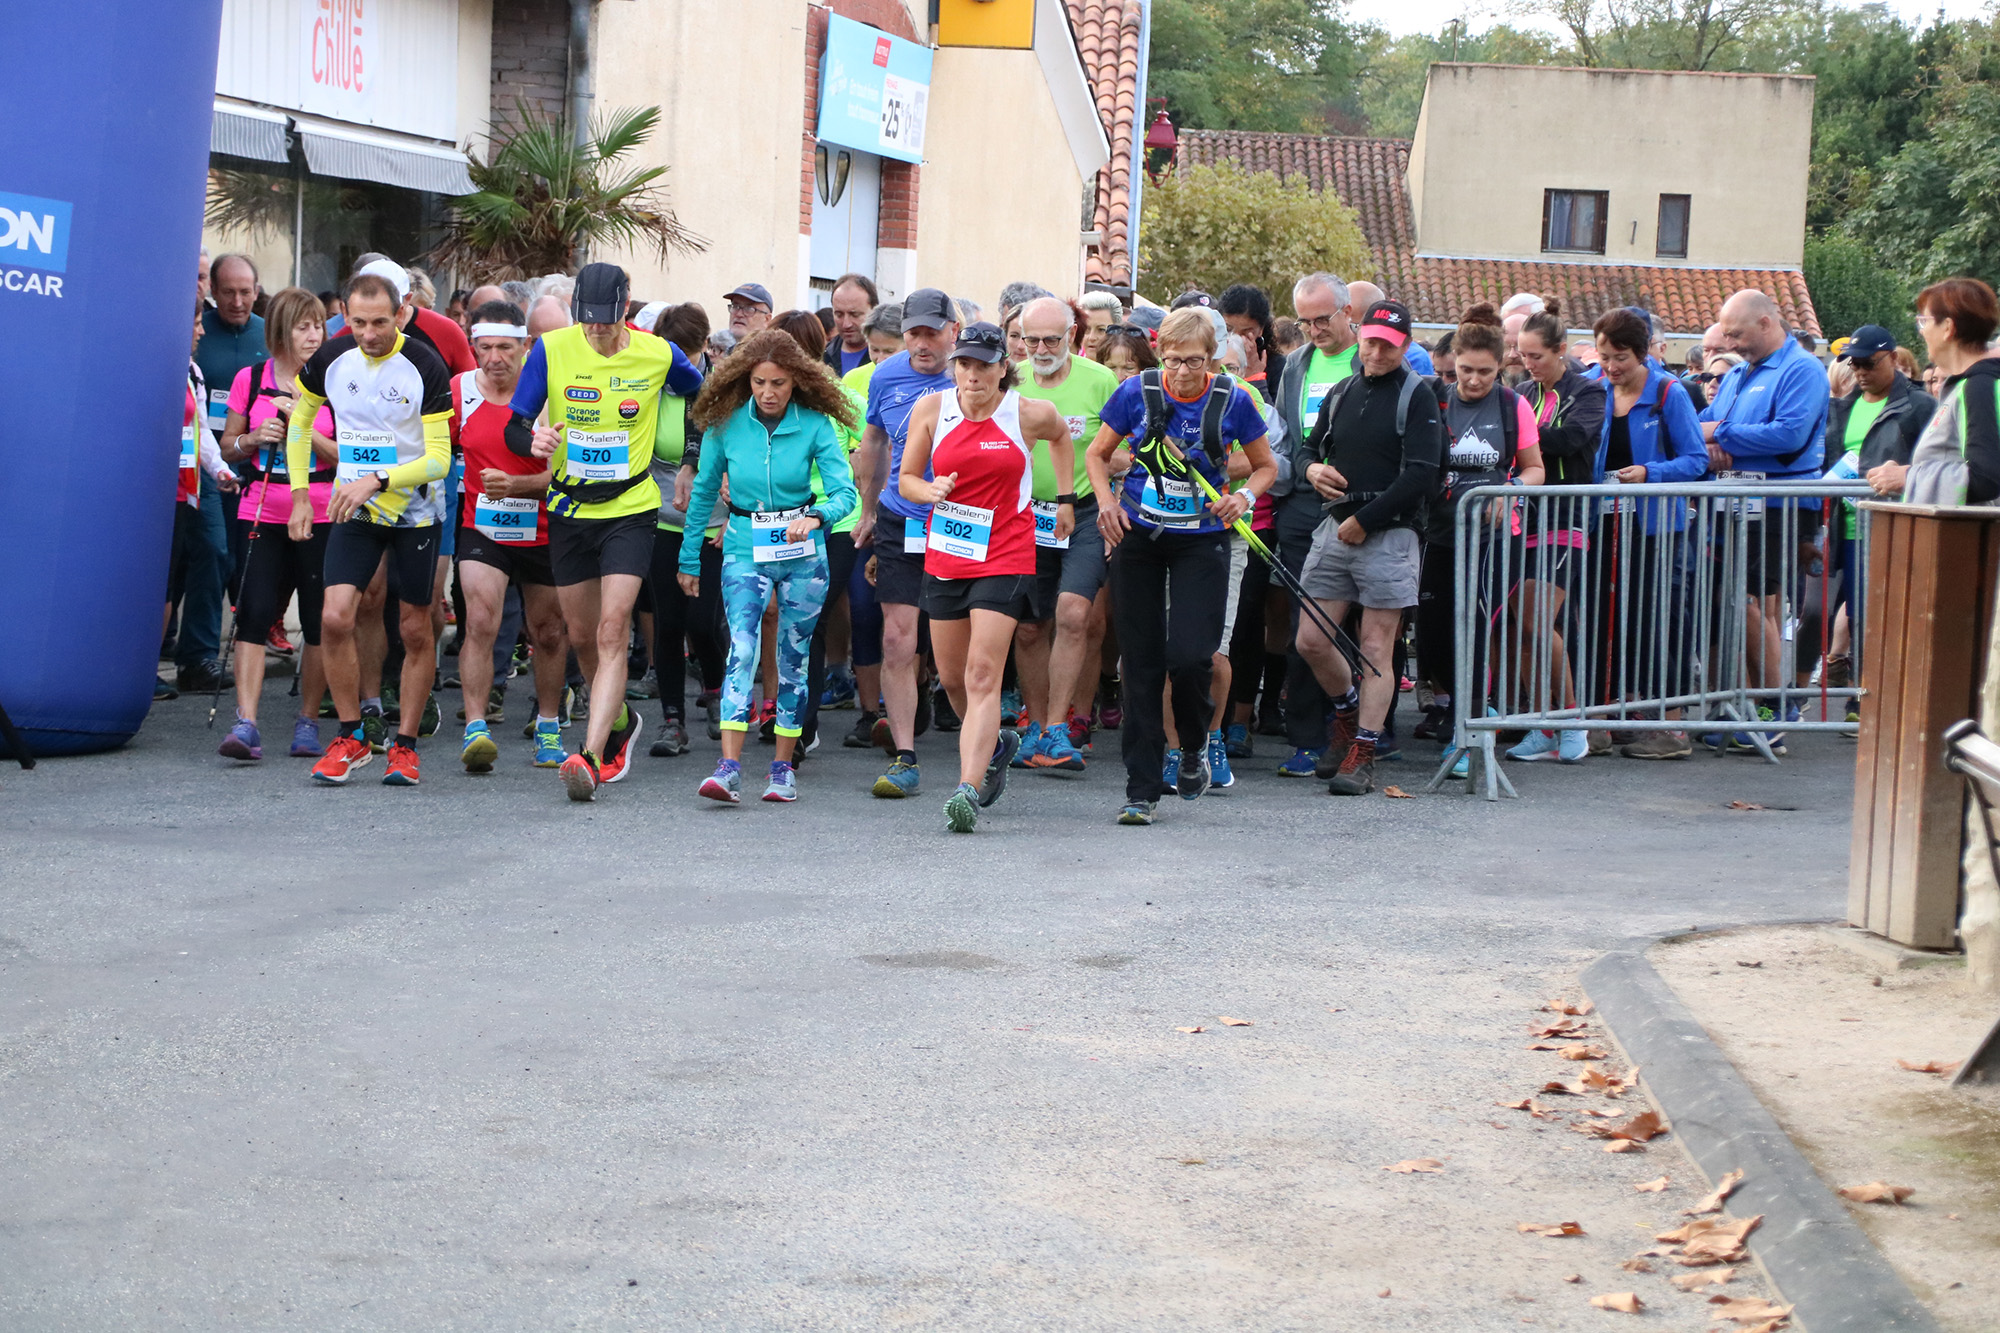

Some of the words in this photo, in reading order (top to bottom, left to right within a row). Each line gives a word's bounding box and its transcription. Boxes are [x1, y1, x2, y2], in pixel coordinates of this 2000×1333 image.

[571, 390, 595, 398] SEDB
[355, 433, 393, 443] Kalenji
[586, 434, 626, 443] Kalenji
[353, 448, 380, 462] 542
[582, 449, 611, 462] 570
[491, 513, 520, 525] 424
[950, 505, 991, 522] Kalenji
[944, 520, 972, 539] 502
